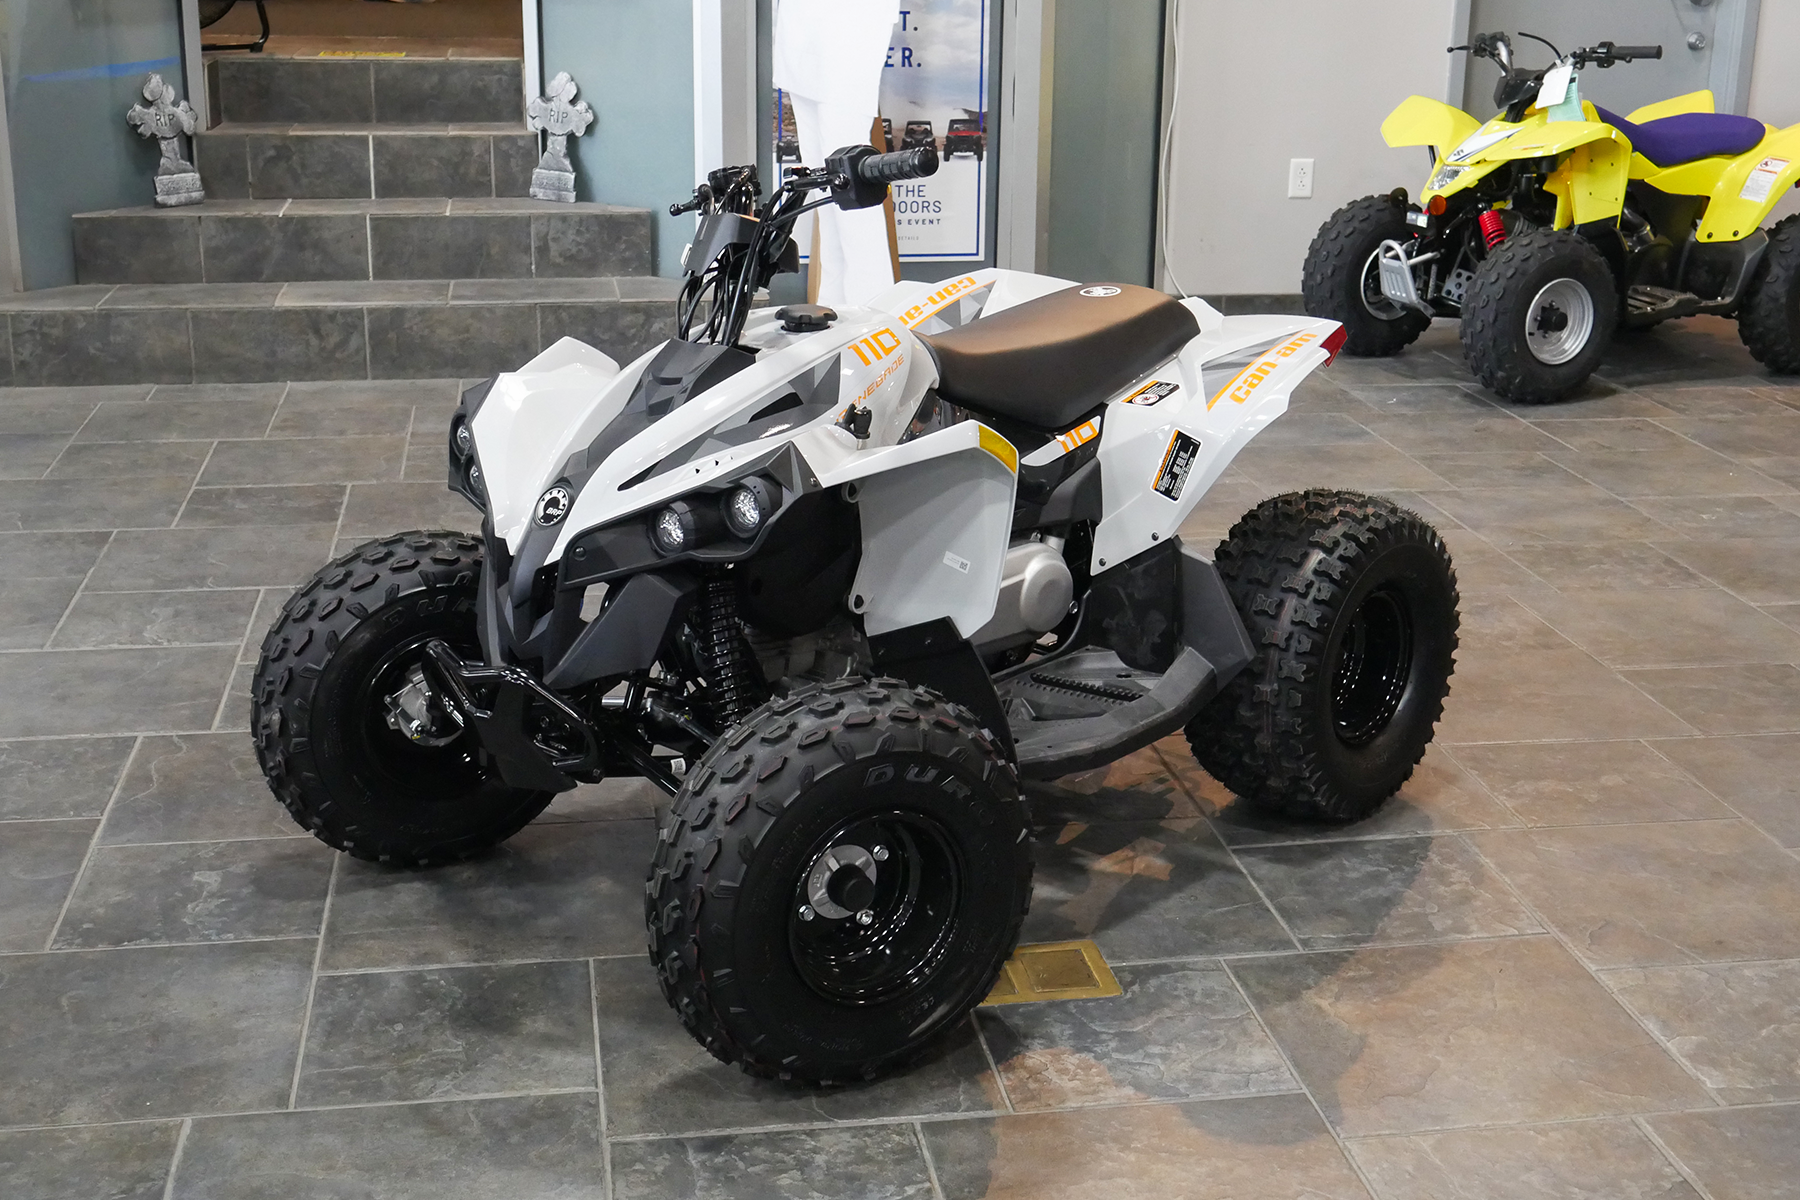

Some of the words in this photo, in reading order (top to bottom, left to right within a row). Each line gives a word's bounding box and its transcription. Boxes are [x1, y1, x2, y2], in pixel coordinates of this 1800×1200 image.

[155, 112, 175, 127] RIP
[548, 108, 568, 124] RIP
[895, 185, 926, 197] THE
[893, 201, 941, 213] OORS
[848, 328, 902, 367] 110
[1056, 420, 1099, 453] 110
[545, 506, 563, 516] BRP
